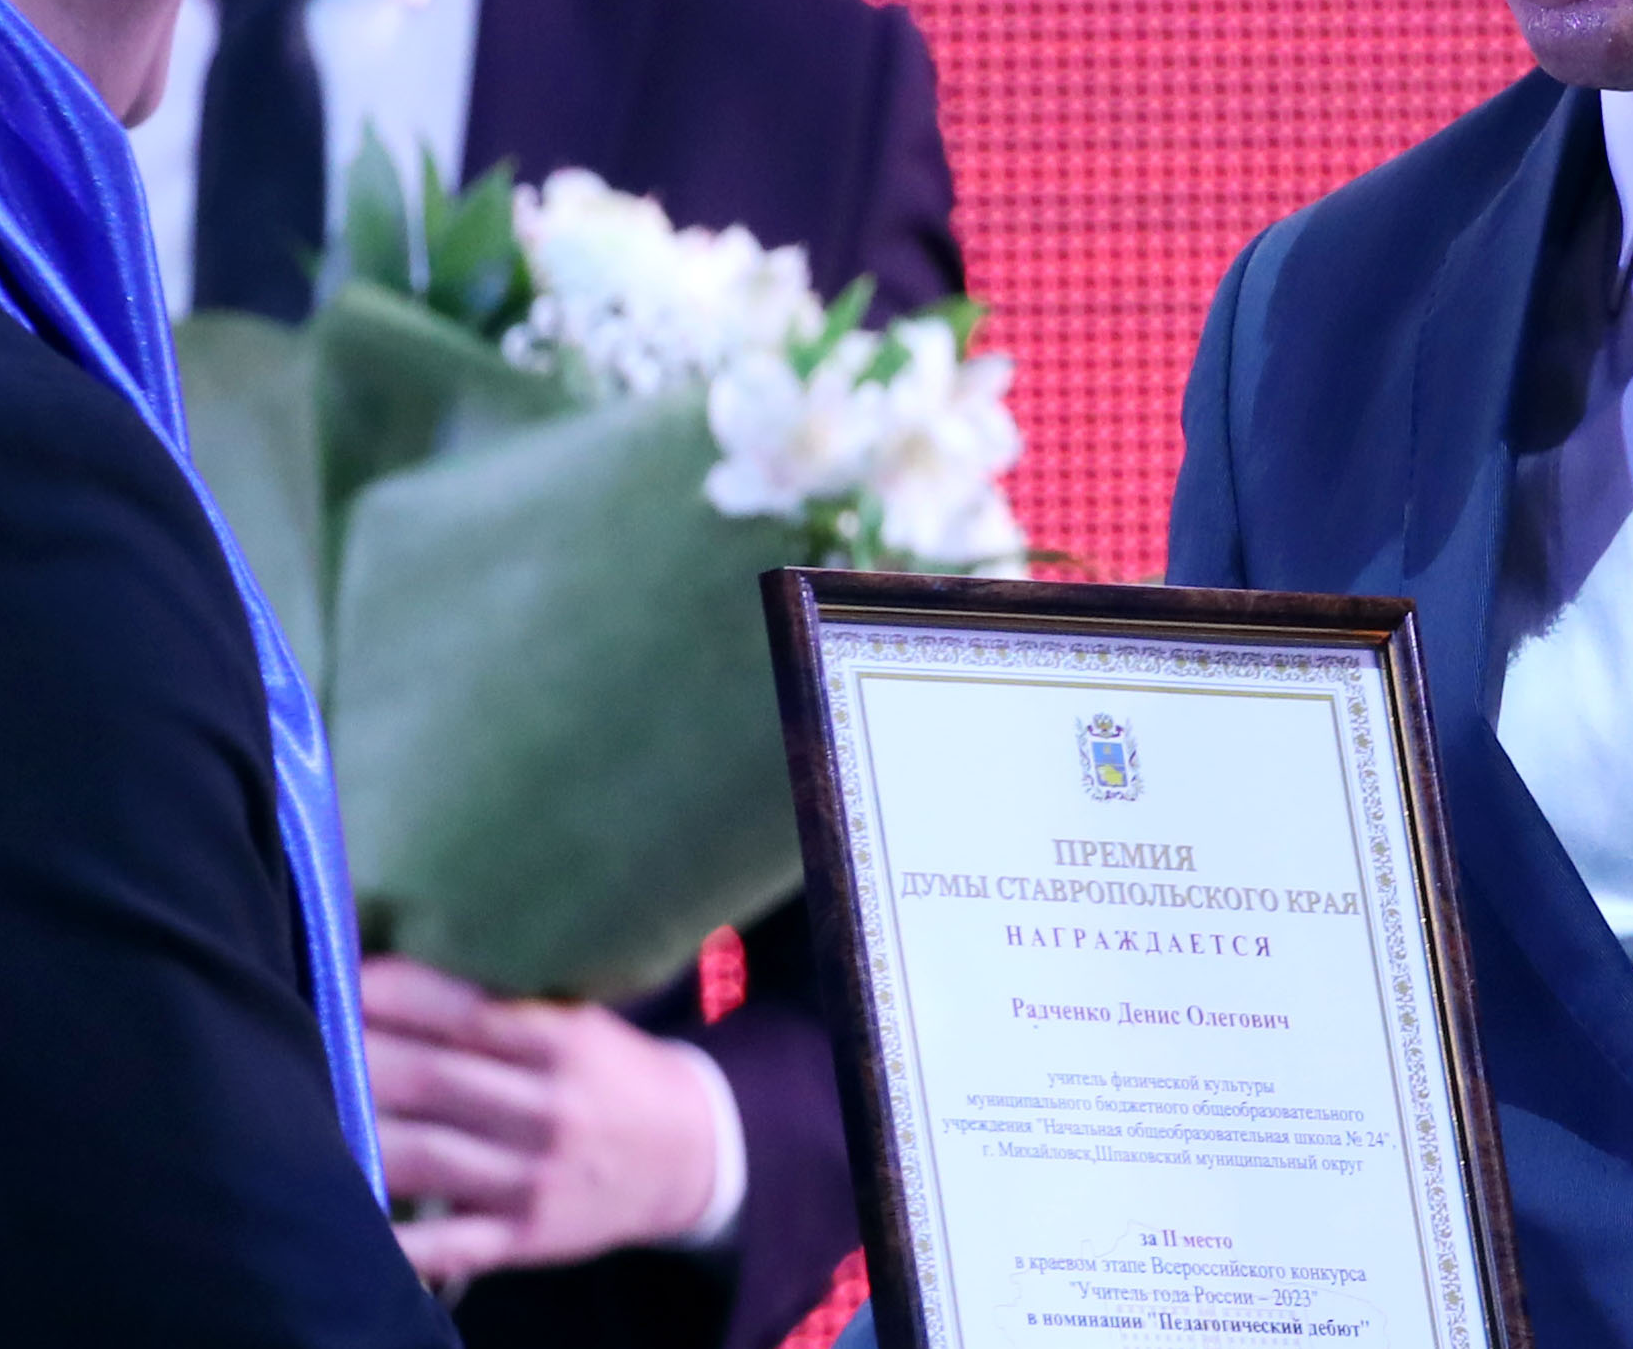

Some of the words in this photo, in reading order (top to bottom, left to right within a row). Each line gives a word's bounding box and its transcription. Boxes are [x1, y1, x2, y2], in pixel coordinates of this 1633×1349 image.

[1051, 838, 1198, 873] ПРЕМИЯ
[900, 871, 991, 900] ДУМЫ
[996, 875, 1279, 913] СТАВРОПОЛЬСКОГО
[1286, 889, 1362, 916] КРАЯ
[1005, 924, 1273, 958] НАГРАЖДАЕТСЯ
[1011, 997, 1111, 1024] Радченко
[1117, 1001, 1181, 1027] Денис
[1186, 1004, 1290, 1030] Олегович
[1047, 1072, 1108, 1089] учитель
[1110, 1071, 1200, 1092] физической
[1203, 1079, 1276, 1098] культуры
[966, 1093, 1092, 1111] муниципального
[1095, 1094, 1189, 1116] бюджетного
[1192, 1100, 1365, 1122] общеобразовательного
[942, 1117, 1034, 1136] учреждения
[1127, 1122, 1291, 1145] общеобразовательная
[1294, 1131, 1343, 1147] школа
[1345, 1130, 1363, 1148] №
[982, 1144, 995, 1159] г.
[1195, 1151, 1318, 1171] муниципальный
[1321, 1157, 1364, 1176] округ
[1139, 1231, 1157, 1248] за
[1182, 1234, 1234, 1250] место
[1015, 1256, 1025, 1269] в
[1029, 1257, 1098, 1275] краевом
[1101, 1258, 1146, 1275] этапе
[1150, 1255, 1286, 1280] Всероссийского
[1290, 1266, 1368, 1286] конкурса
[1069, 1281, 1149, 1303] "Учитель
[1152, 1287, 1191, 1304] года
[1194, 1285, 1255, 1305] России
[1273, 1288, 1318, 1308] 2023"
[1027, 1313, 1037, 1326] в
[1042, 1312, 1143, 1330] номинации
[1147, 1311, 1303, 1336] "Педагогический
[1308, 1319, 1370, 1338] дебют"
